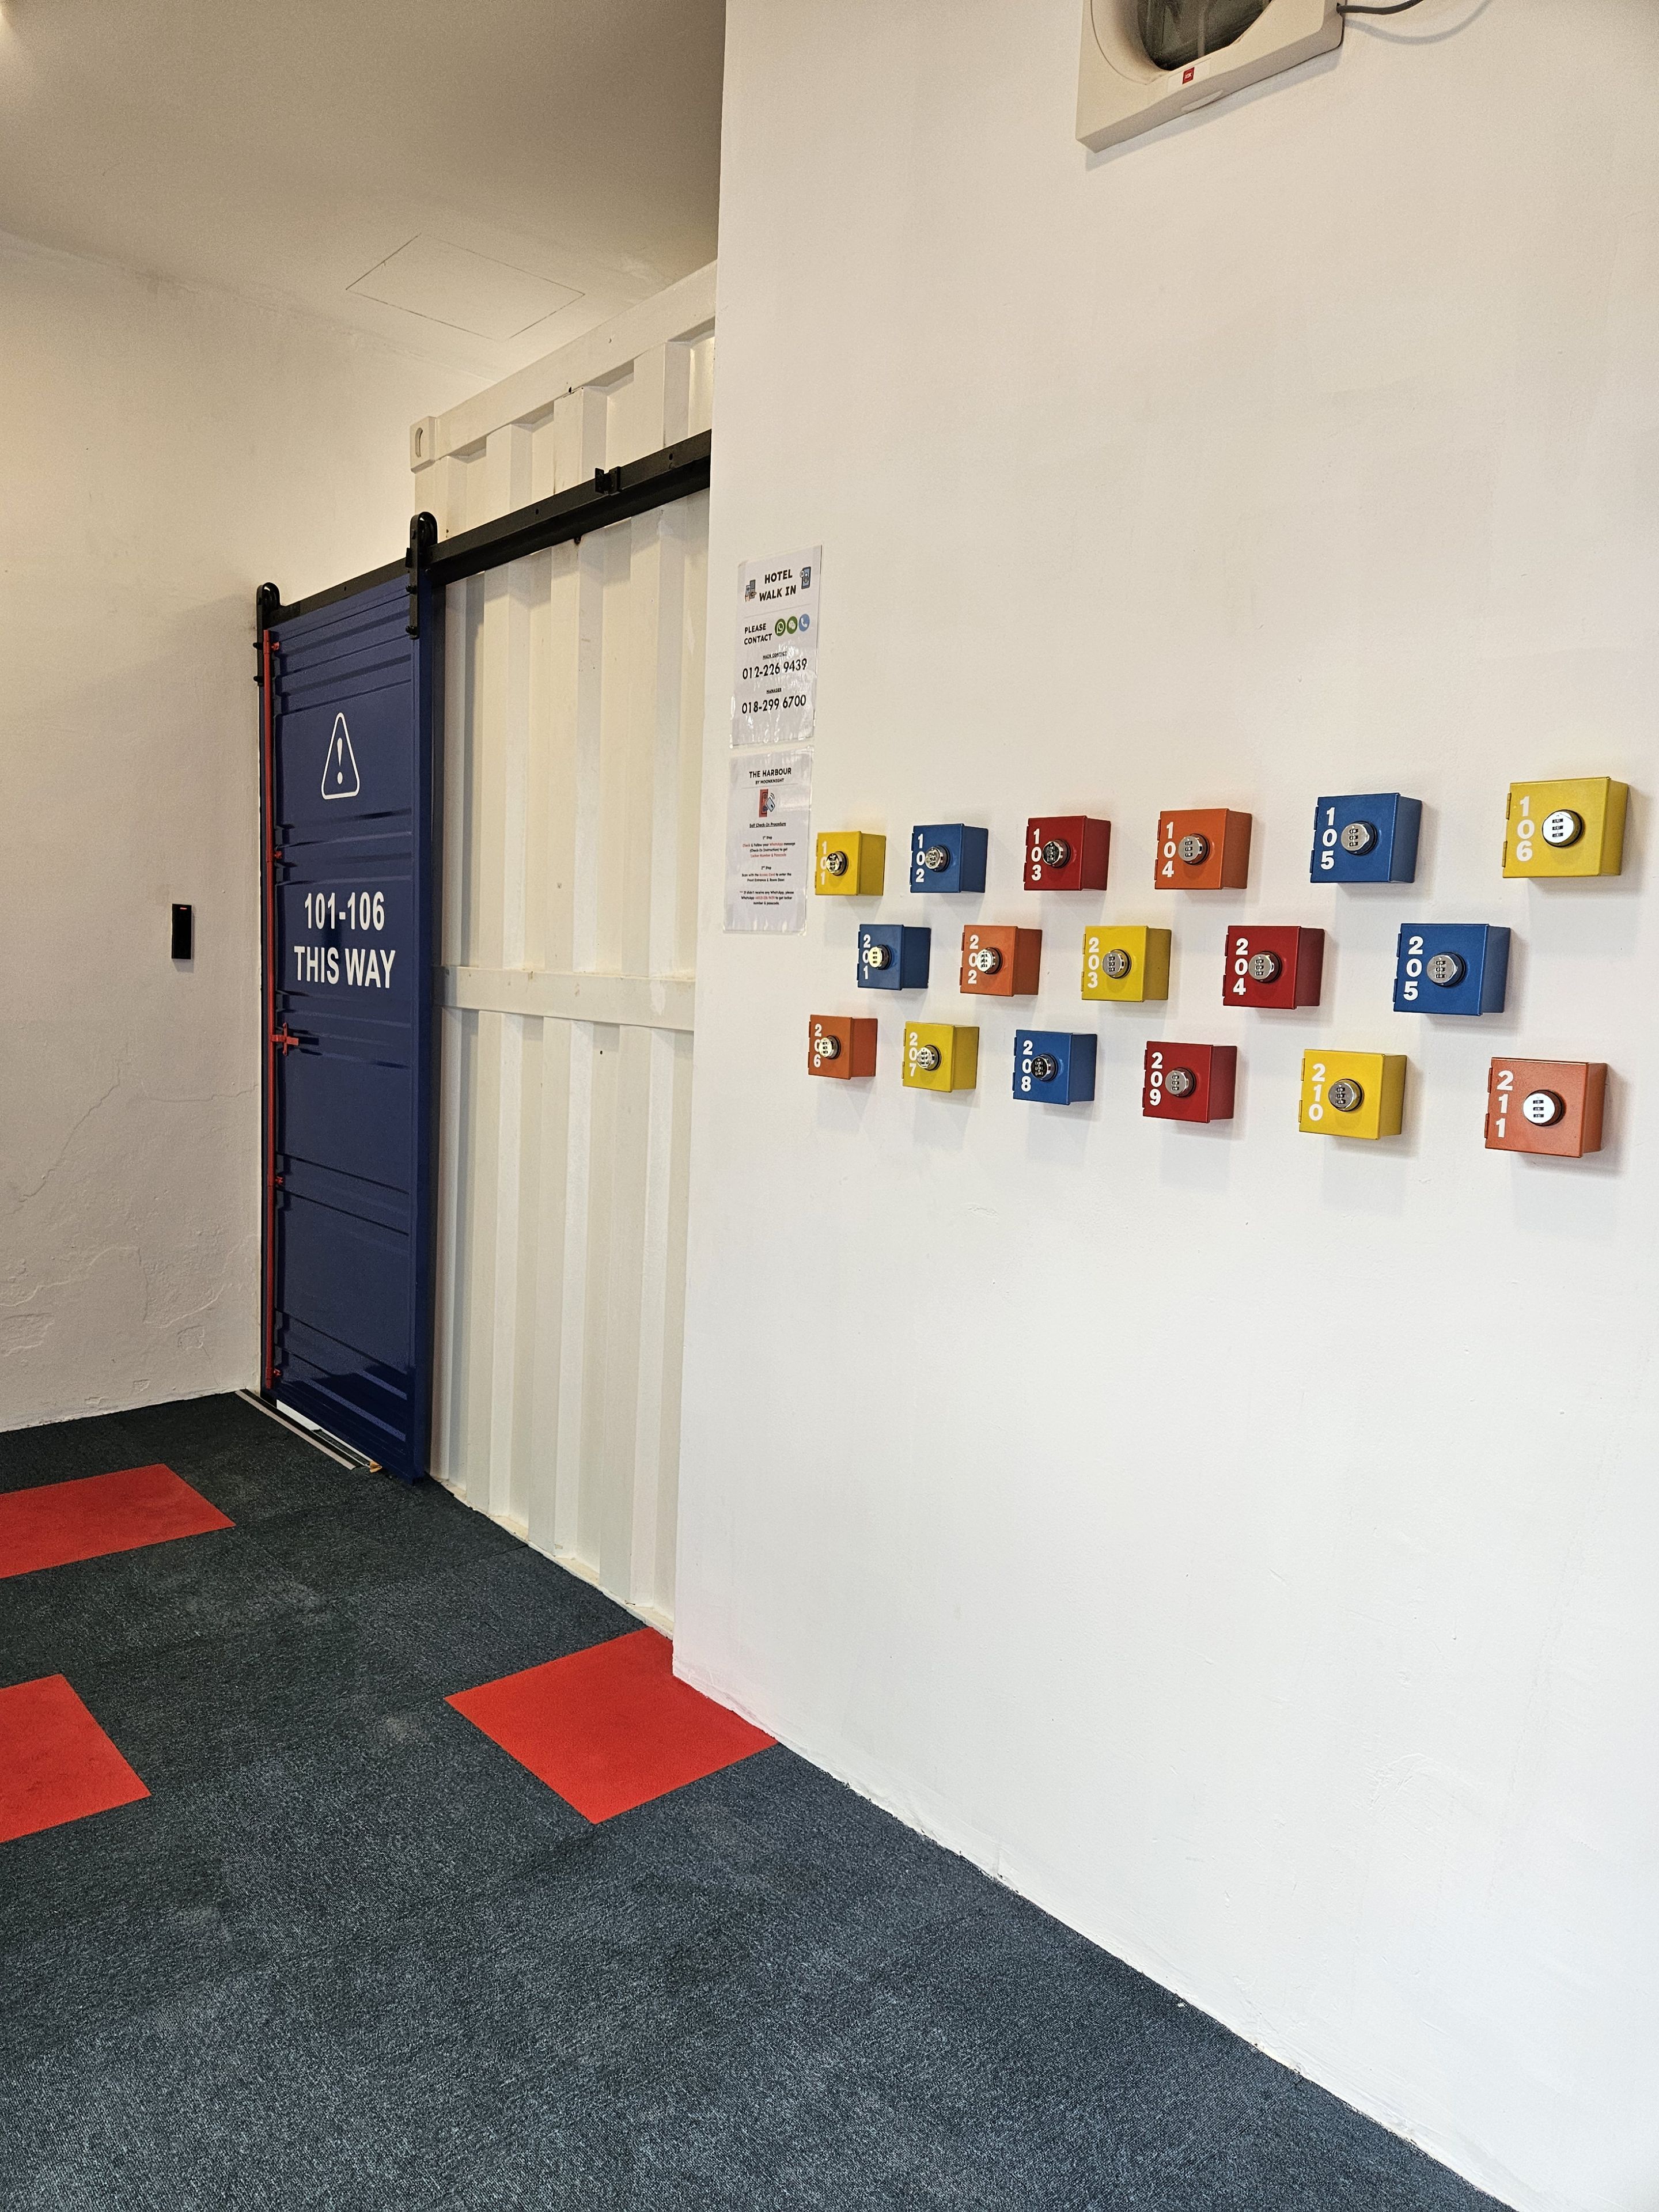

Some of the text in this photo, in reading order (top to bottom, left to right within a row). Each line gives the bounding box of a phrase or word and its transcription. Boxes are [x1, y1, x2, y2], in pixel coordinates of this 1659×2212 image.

[759, 585, 797, 601] WALK IN
[764, 569, 793, 584] HOTEL
[744, 623, 766, 634] PLEASE
[744, 633, 772, 645] CONTACT
[742, 658, 808, 680] 012-226 9439
[741, 694, 806, 714] 018-299 6700
[762, 767, 791, 777] HARBOUR
[1162, 821, 1176, 877] 104
[1321, 807, 1338, 870] 105
[1517, 796, 1535, 862] 106
[916, 834, 926, 882] 102
[1032, 828, 1042, 881] 103
[305, 891, 385, 931] 101-106
[294, 946, 396, 988] THIS WAY
[863, 934, 871, 980] 201
[968, 934, 979, 984] 202
[1088, 937, 1099, 988] 203
[1233, 938, 1249, 995] 204
[1403, 935, 1423, 1001] 205
[909, 1032, 918, 1077] 207
[1021, 1040, 1033, 1092] 208
[1150, 1052, 1163, 1106] 209
[1309, 1063, 1325, 1121] 210
[1496, 1070, 1514, 1138] 211
